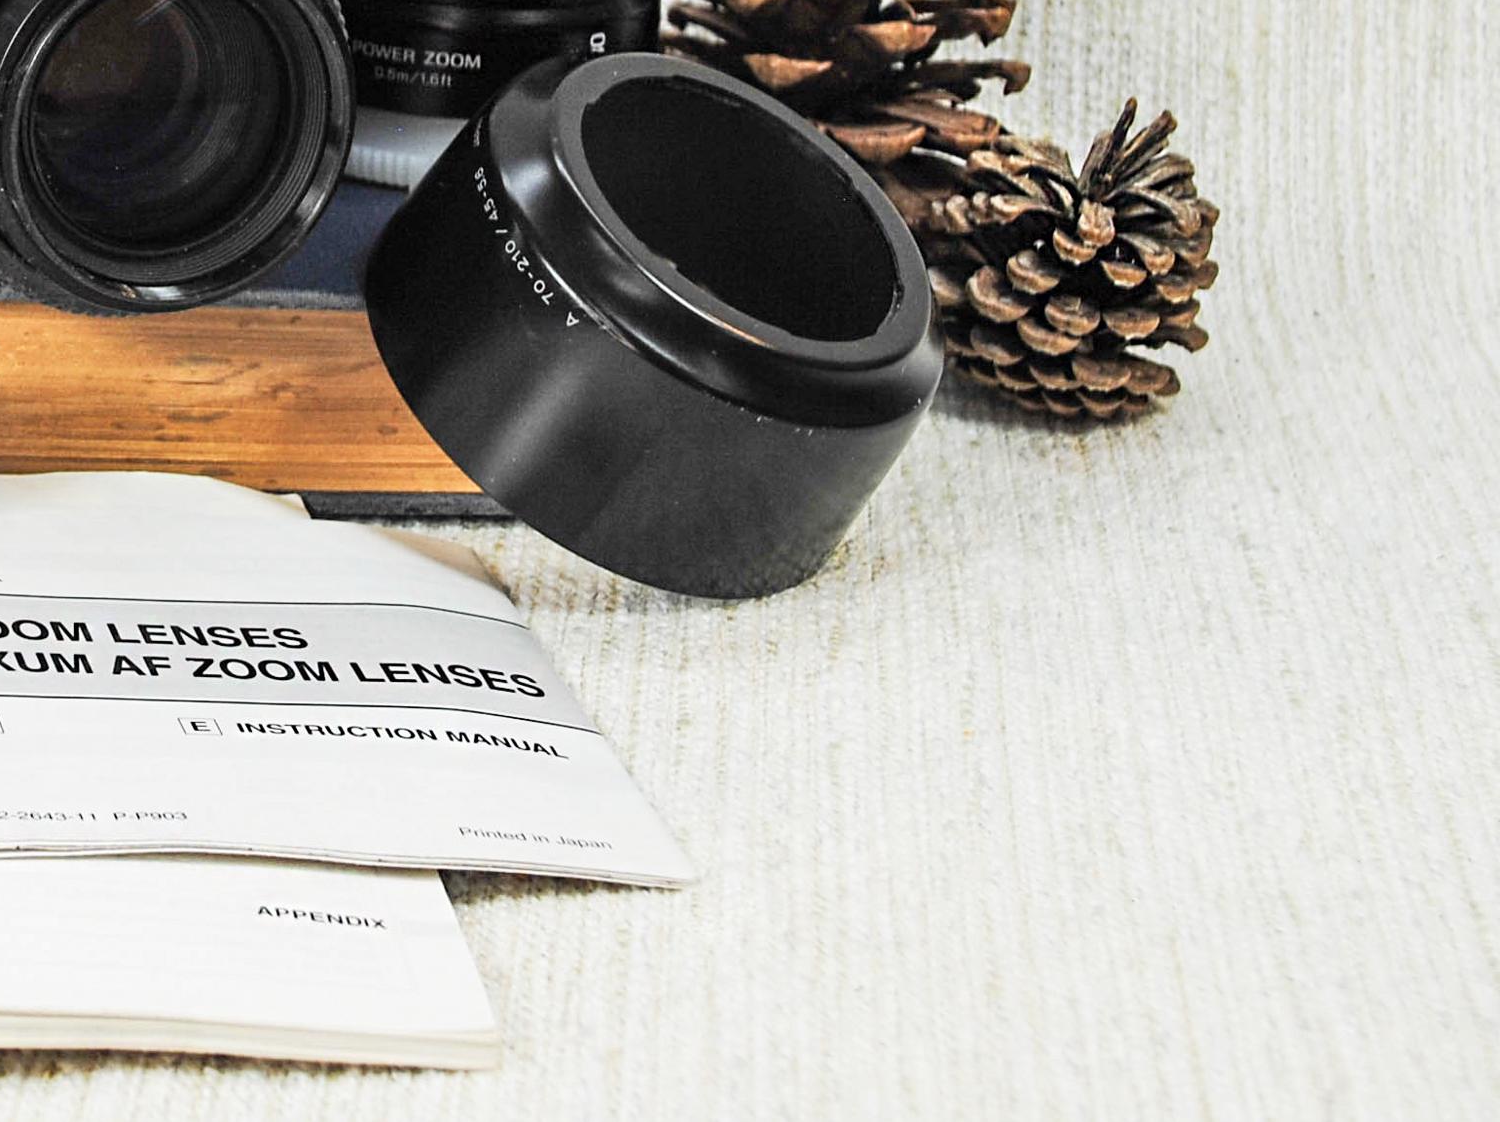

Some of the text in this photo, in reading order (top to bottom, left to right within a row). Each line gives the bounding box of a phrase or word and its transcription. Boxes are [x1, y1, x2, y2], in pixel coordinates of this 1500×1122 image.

[352, 38, 482, 70] POWER ZOOM
[504, 239, 555, 306] 70-210
[565, 311, 580, 327] A
[105, 621, 309, 650] LENSES
[111, 655, 172, 677] AF
[186, 657, 340, 682] ZOOM
[349, 660, 547, 698] LENSES
[190, 720, 570, 760] E INSTRUCTION MANUAL
[457, 826, 614, 851] Printed in Japan
[257, 904, 389, 931] APPENDIX
